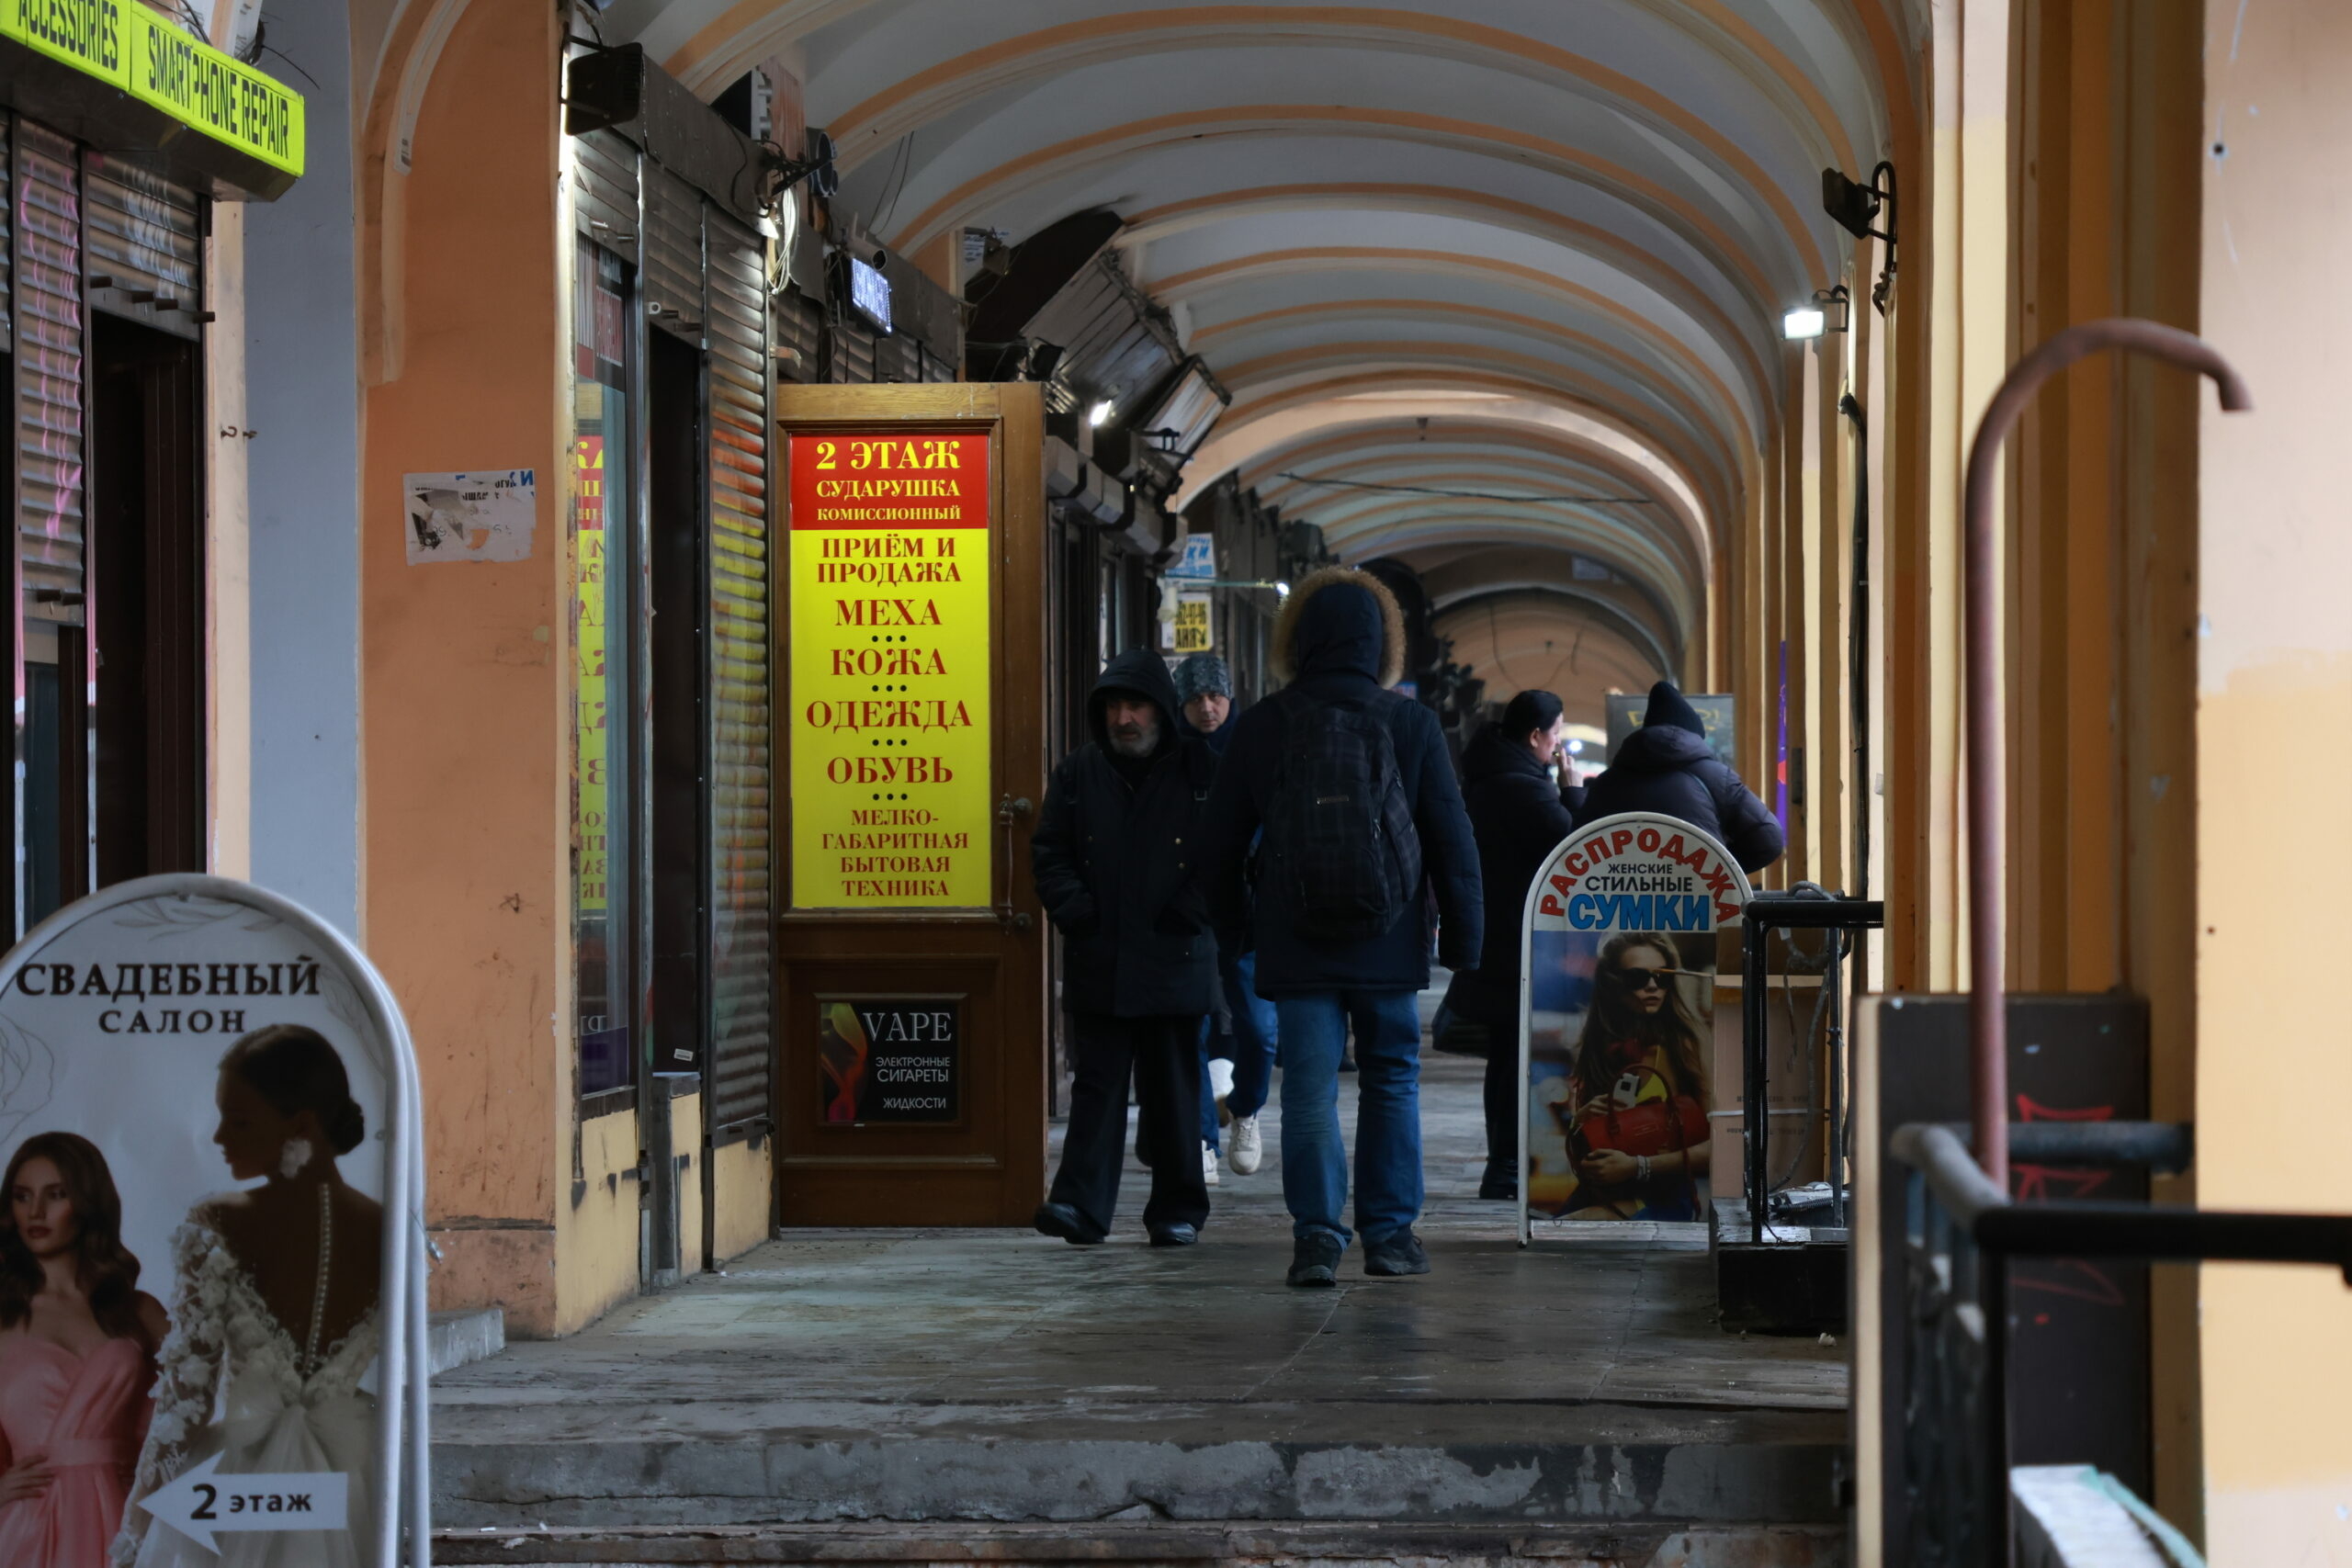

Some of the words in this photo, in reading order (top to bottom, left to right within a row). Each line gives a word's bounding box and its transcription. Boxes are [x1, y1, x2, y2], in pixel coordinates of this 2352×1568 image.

[148, 24, 238, 136] SMARTPHONE
[242, 80, 288, 160] REPAIR
[816, 442, 836, 469] 2
[850, 441, 961, 469] ЭТАЖ
[816, 479, 961, 501] СУДАРУШКА
[817, 505, 961, 521] КОМИССИОННЫЙ
[821, 534, 924, 558] ПРИЁМ
[936, 537, 956, 558] И
[817, 562, 962, 587] ПРОДАЖА
[835, 599, 943, 626] МЕХА
[831, 649, 948, 675] КОЖА
[807, 700, 973, 734] ОДЕЖДА
[828, 757, 954, 784] ОБУВЬ
[852, 809, 939, 826] МЕЛКО-
[822, 833, 968, 850] ГАБАРИТНАЯ
[841, 856, 951, 874] БЫТОВАЯ
[1540, 829, 1740, 923] РАСПРОДАЖА
[1608, 863, 1673, 874] ЖЕНСКИЕ
[842, 880, 950, 897] ТЕХНИКА
[1585, 876, 1692, 892] СТИЛЬНЫЕ
[1568, 894, 1710, 931] СУМКИ
[16, 955, 321, 1003] СВАДЕБНЫЙ
[98, 1010, 245, 1033] САЛОН
[862, 1012, 952, 1042] VAPE
[876, 1057, 951, 1067] ЭЛЕКТРОННЫЕ
[876, 1069, 949, 1082] СИГАРЕТЫ
[883, 1098, 946, 1111] ЖИДКОСТИ
[189, 1483, 217, 1520] 2
[229, 1494, 311, 1513] этаж
